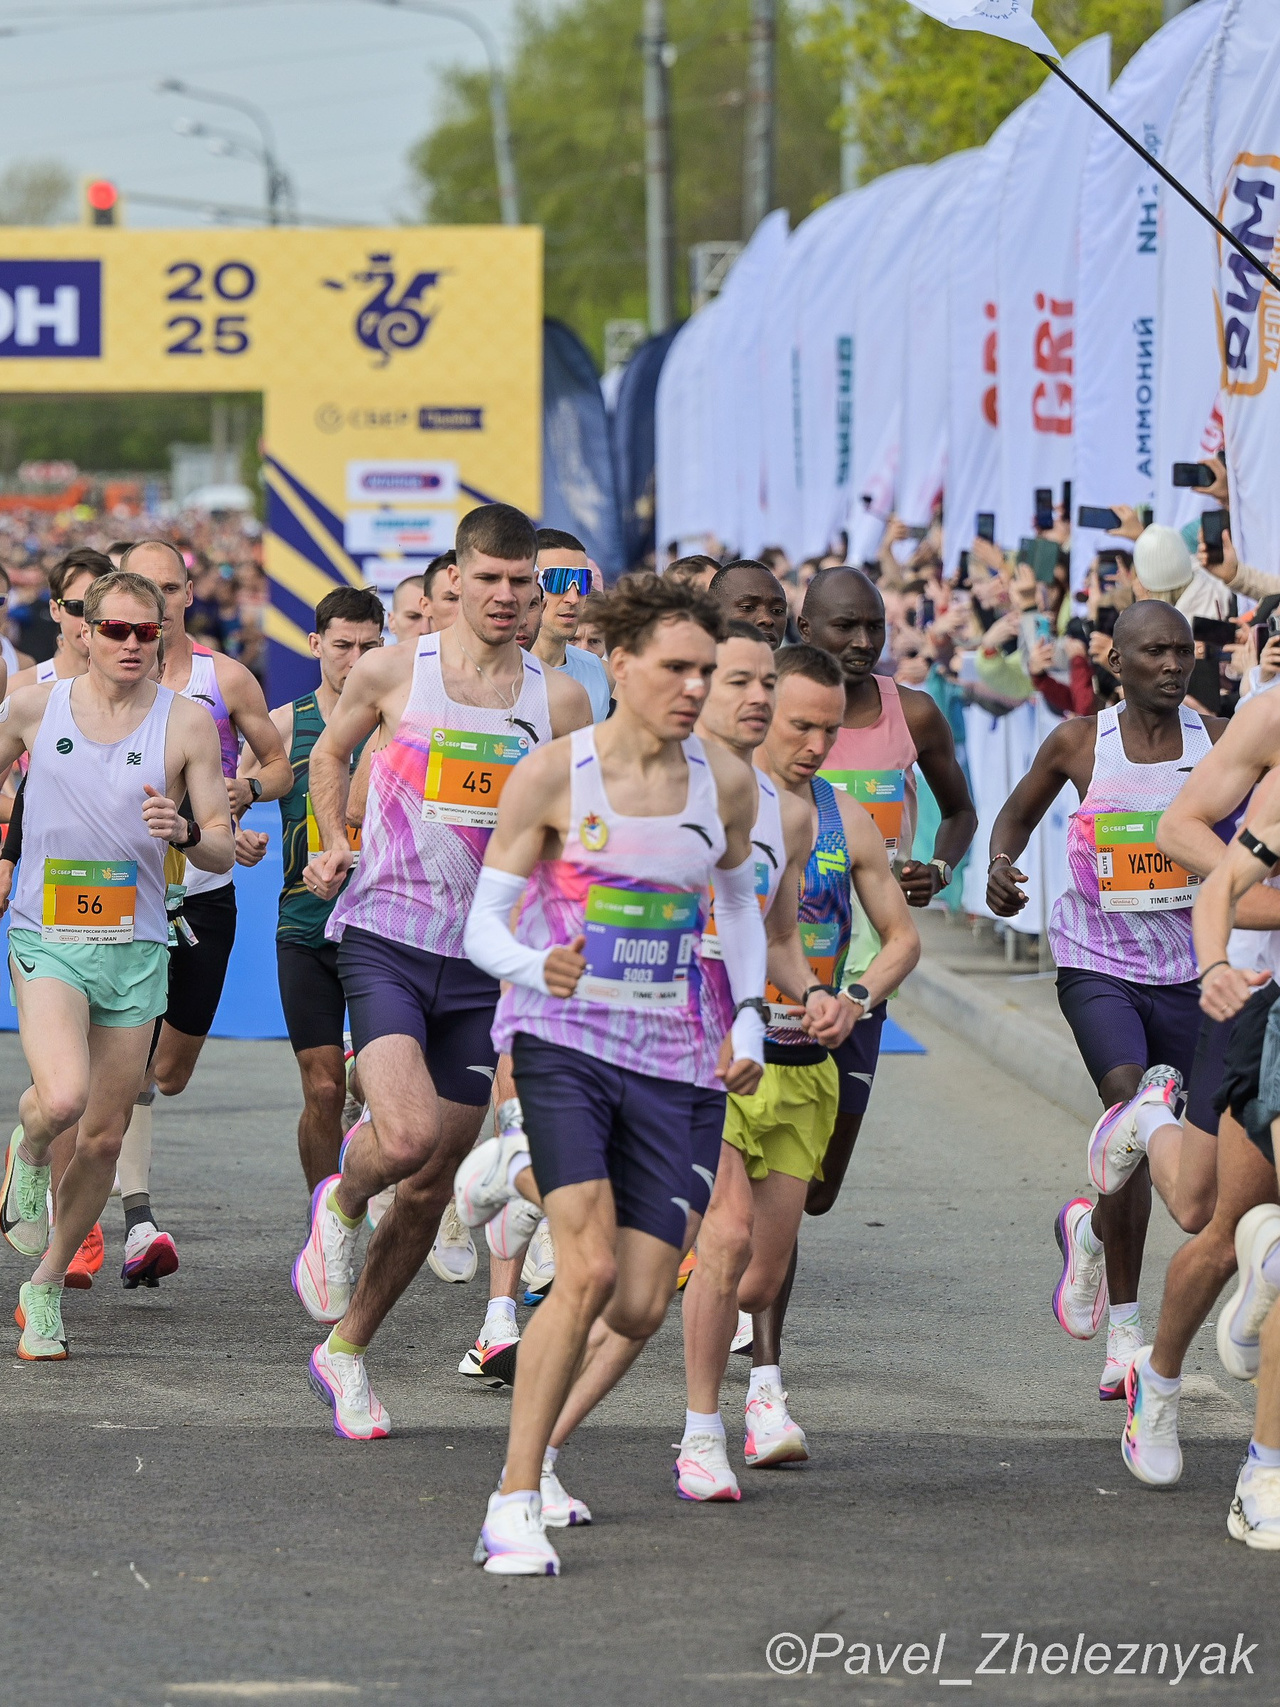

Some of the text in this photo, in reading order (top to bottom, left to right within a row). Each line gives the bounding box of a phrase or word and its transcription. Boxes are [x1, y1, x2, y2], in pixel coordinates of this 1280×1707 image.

[166, 260, 258, 302] 20
[166, 314, 250, 355] 25
[1031, 291, 1074, 436] GRi
[1133, 315, 1156, 478] АММОНИЙ
[462, 770, 493, 794] 45
[1128, 852, 1173, 875] YATOR
[1148, 878, 1155, 890] 6
[77, 894, 103, 915] 56
[612, 937, 670, 966] ПОПОВ
[623, 967, 654, 983] 5003
